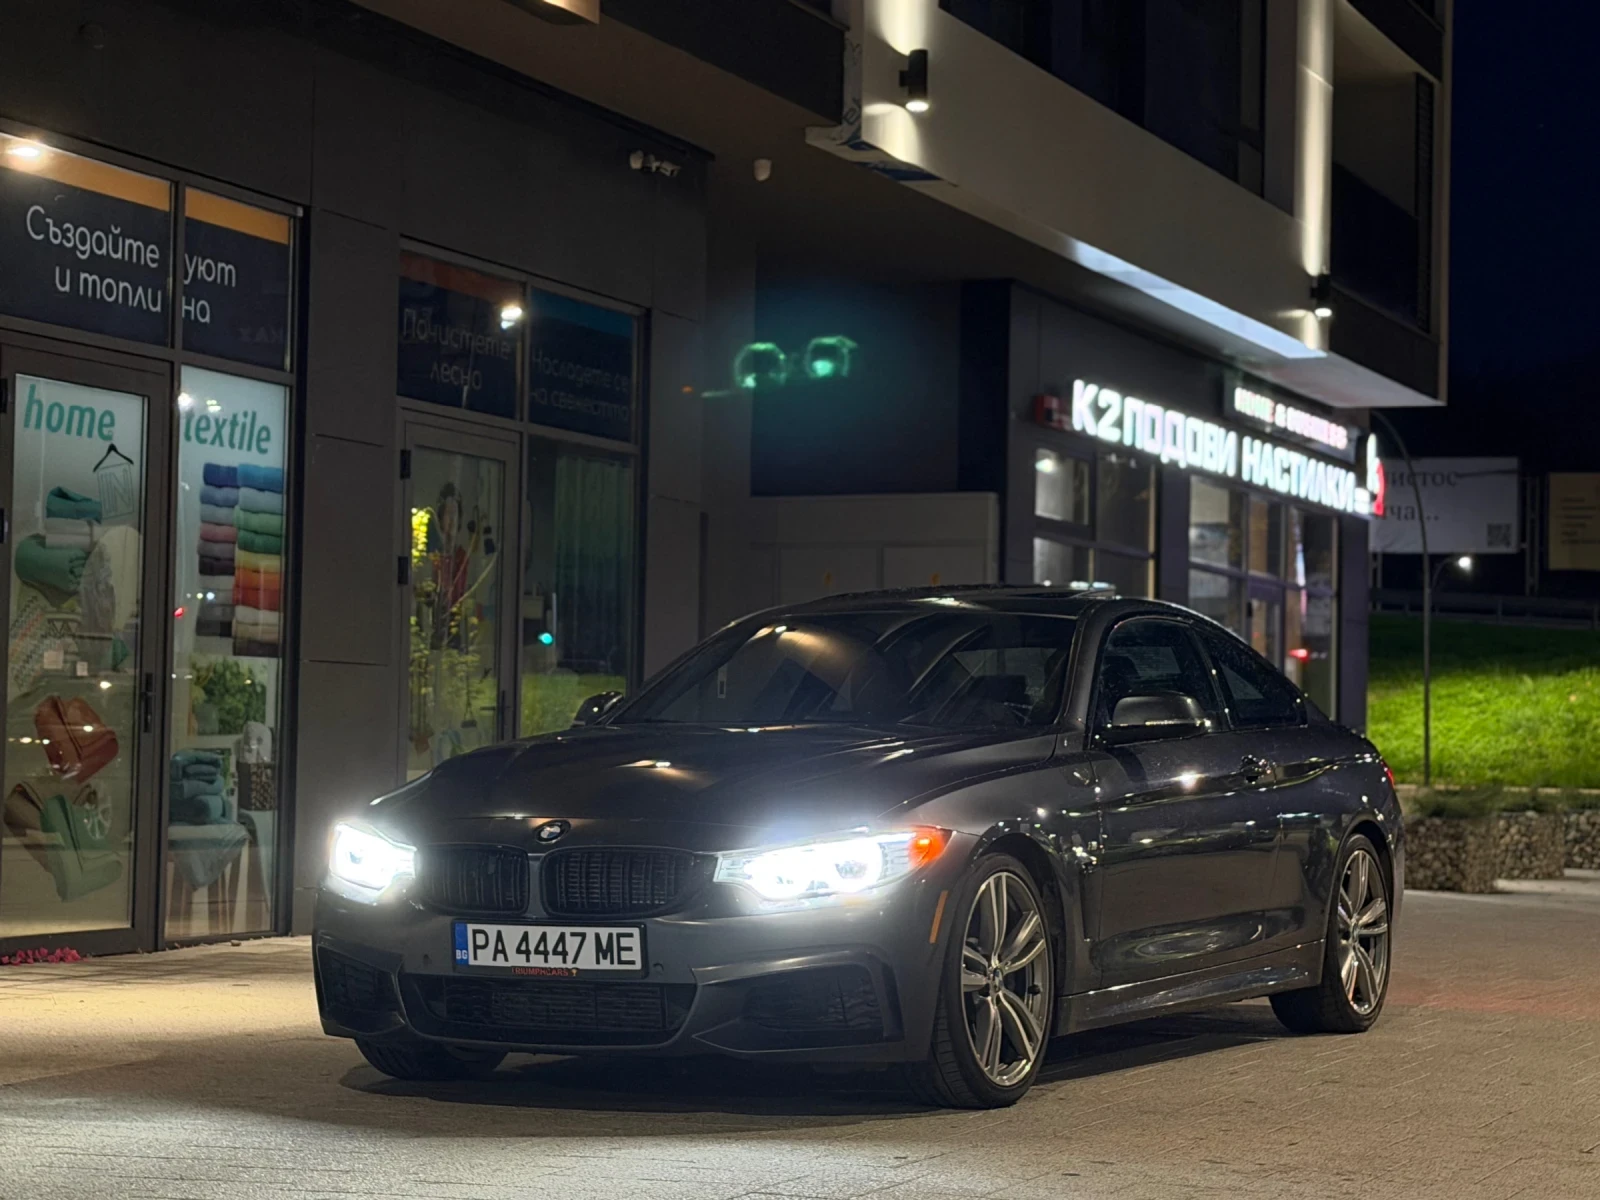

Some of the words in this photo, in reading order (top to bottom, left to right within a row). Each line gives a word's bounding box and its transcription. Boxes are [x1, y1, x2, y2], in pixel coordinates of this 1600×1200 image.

[26, 205, 160, 268] Създайте
[183, 253, 237, 287] уют
[55, 266, 71, 292] и
[23, 383, 116, 440] home
[183, 409, 272, 454] textile
[1241, 436, 1356, 514] НАСТИЛКИ
[455, 949, 468, 960] BG
[471, 928, 509, 962] PA
[515, 930, 587, 965] 4447
[594, 932, 636, 966] ME
